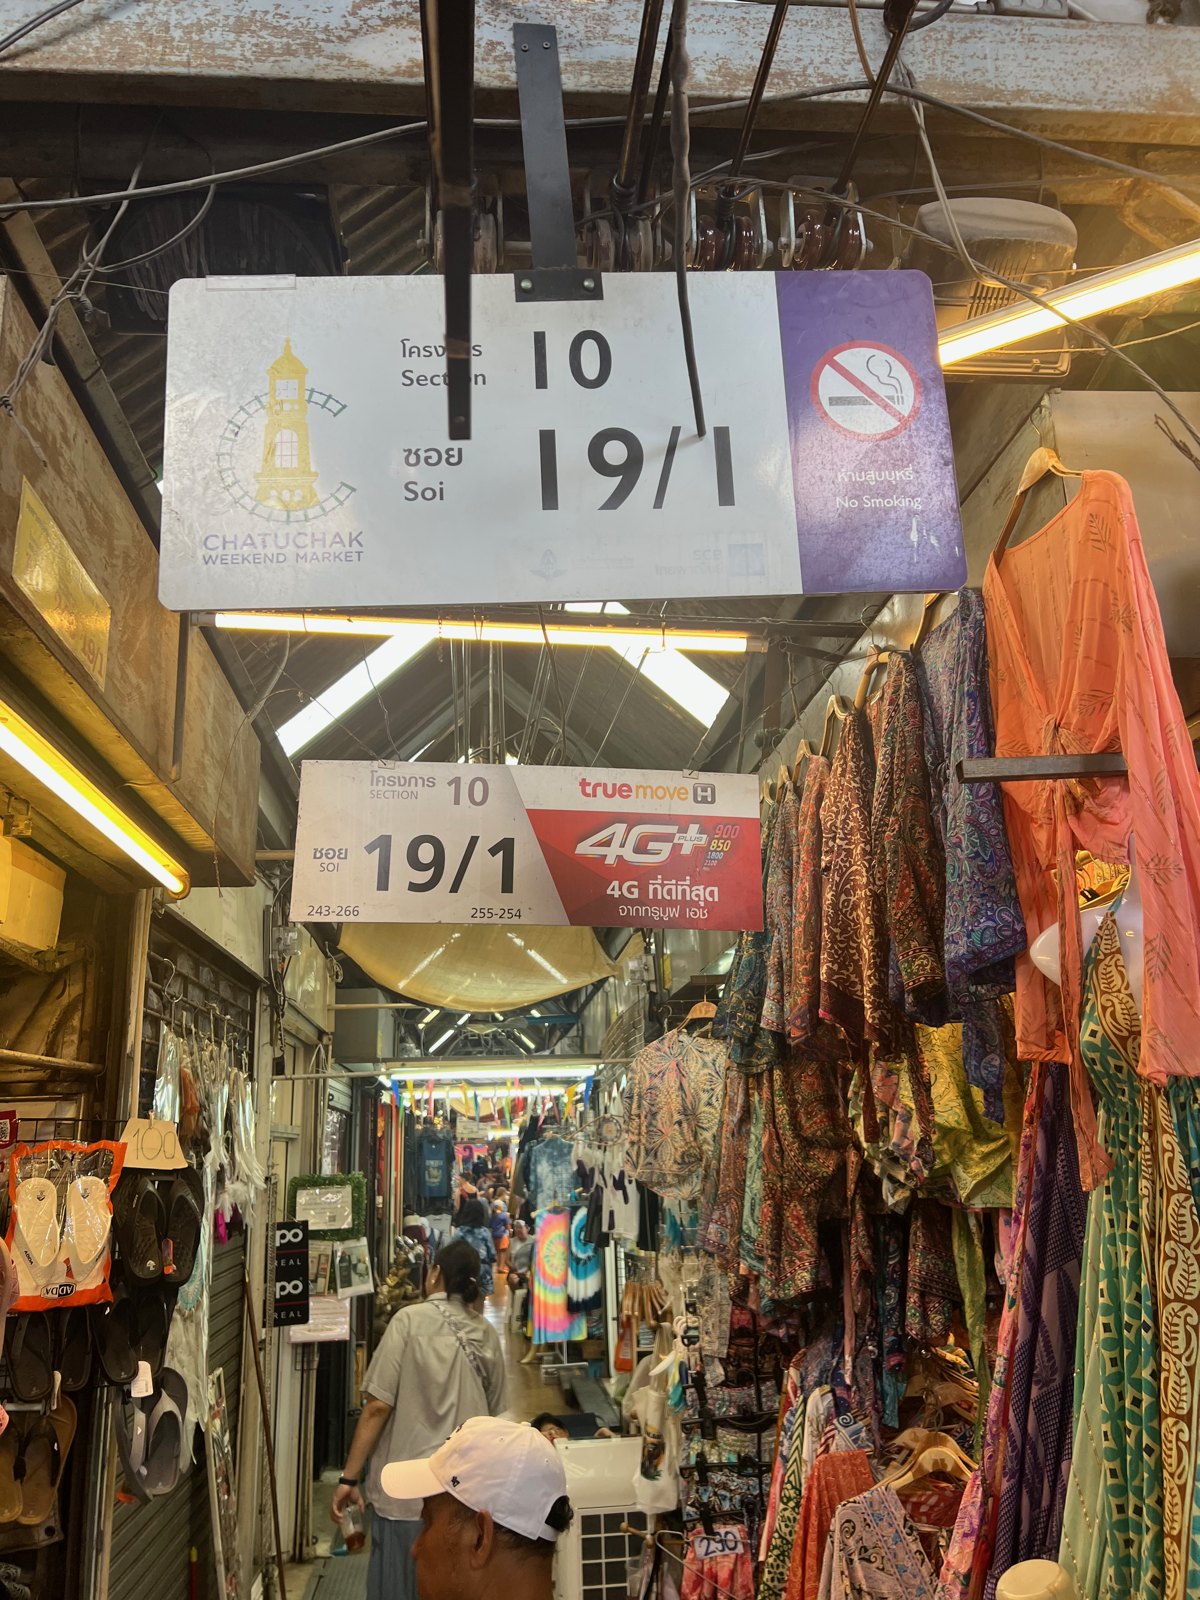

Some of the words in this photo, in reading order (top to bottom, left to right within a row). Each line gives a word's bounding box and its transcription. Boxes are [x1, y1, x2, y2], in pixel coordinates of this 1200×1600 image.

[400, 338, 482, 358] โครงร
[534, 329, 612, 389] 10
[401, 369, 487, 387] Sectn
[403, 446, 464, 467] ซอย
[539, 425, 736, 510] 19/1
[403, 481, 445, 502] Soi
[836, 496, 859, 509] No
[862, 495, 922, 510] Smoking
[203, 531, 364, 552] CHATUCHAK
[202, 552, 287, 565] WEEKEND
[295, 551, 364, 564] MARKET
[369, 770, 437, 789] โครงการ
[369, 790, 419, 800] SECTION
[447, 776, 489, 807] 10
[678, 835, 704, 843] PLUS
[714, 825, 740, 839] 900
[709, 839, 731, 852] 850
[313, 847, 348, 861] ซอย
[706, 852, 724, 860] 1800
[319, 863, 339, 873] SOI
[364, 834, 515, 894] 19/1
[606, 881, 639, 899] 4G
[648, 875, 719, 907] ที่ดีที่สุด
[307, 905, 360, 917] 243-266
[471, 907, 522, 920] 255-254
[686, 907, 708, 920] เอช
[132, 1127, 177, 1161] 100
[45, 1285, 73, 1296] ADDA
